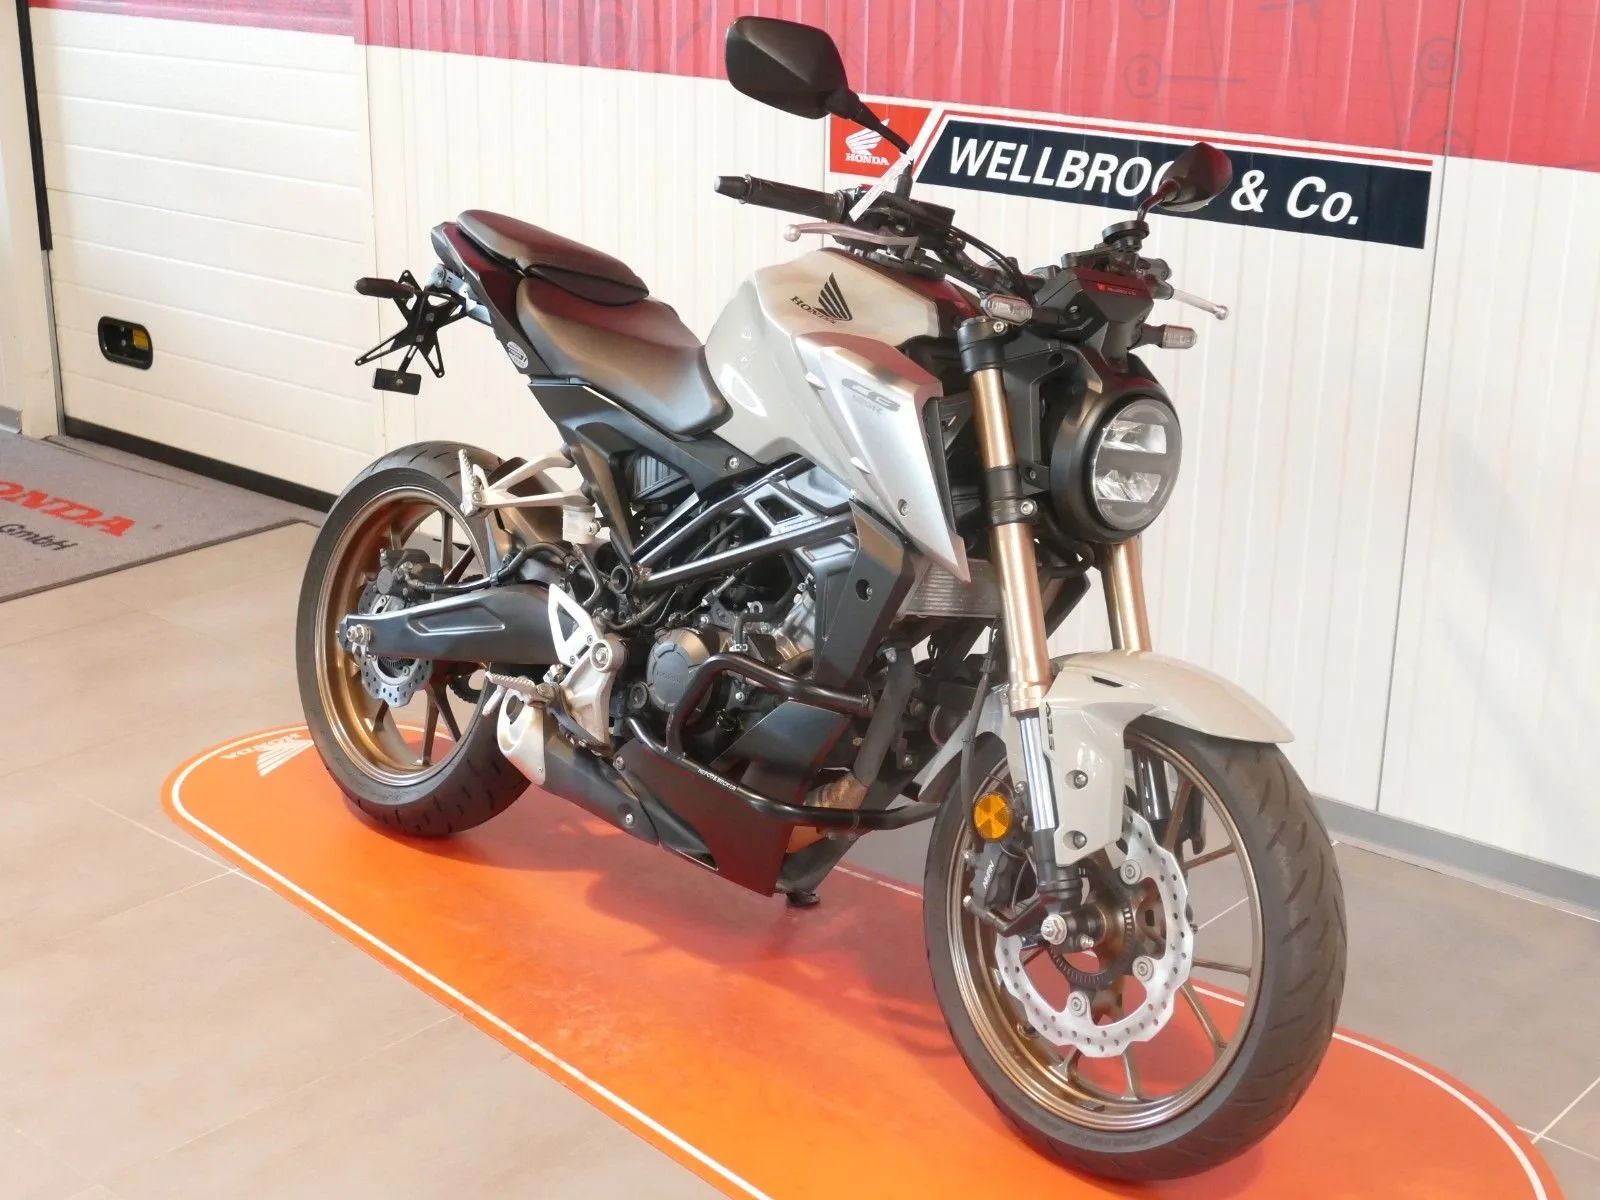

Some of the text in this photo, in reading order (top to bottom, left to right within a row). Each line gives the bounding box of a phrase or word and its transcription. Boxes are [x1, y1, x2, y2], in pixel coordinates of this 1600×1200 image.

[845, 153, 890, 166] HONDA
[950, 136, 1359, 225] WELLBRO & Co.
[790, 296, 836, 324] HONDA
[841, 379, 901, 412] CB
[0, 480, 136, 537] ONDA
[0, 523, 78, 551] GmbH
